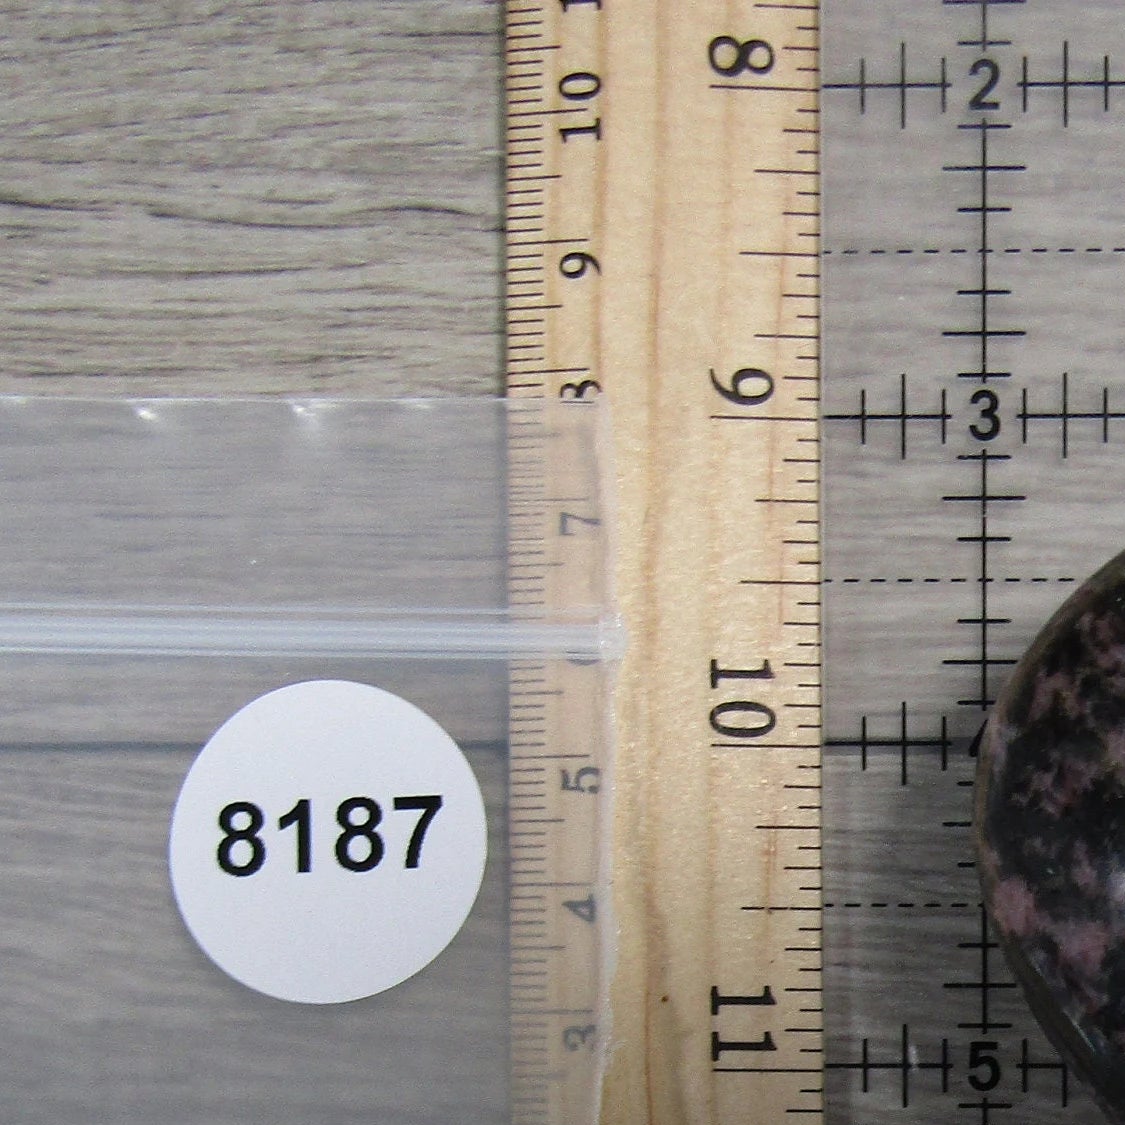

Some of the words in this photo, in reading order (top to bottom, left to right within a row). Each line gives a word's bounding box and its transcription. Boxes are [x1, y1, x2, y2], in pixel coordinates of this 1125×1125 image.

[708, 35, 775, 77] 8
[559, 72, 602, 143] 10
[968, 58, 1001, 111] 2
[559, 252, 602, 279] 9
[709, 367, 775, 406] 9
[968, 389, 1001, 443] 3
[559, 511, 602, 537] 7
[709, 658, 777, 739] 10
[561, 766, 600, 795] 5
[216, 795, 443, 877] 8187
[561, 894, 598, 923] 4
[564, 1023, 597, 1053] 3
[710, 985, 778, 1061] 11
[967, 1041, 1002, 1091] 5
